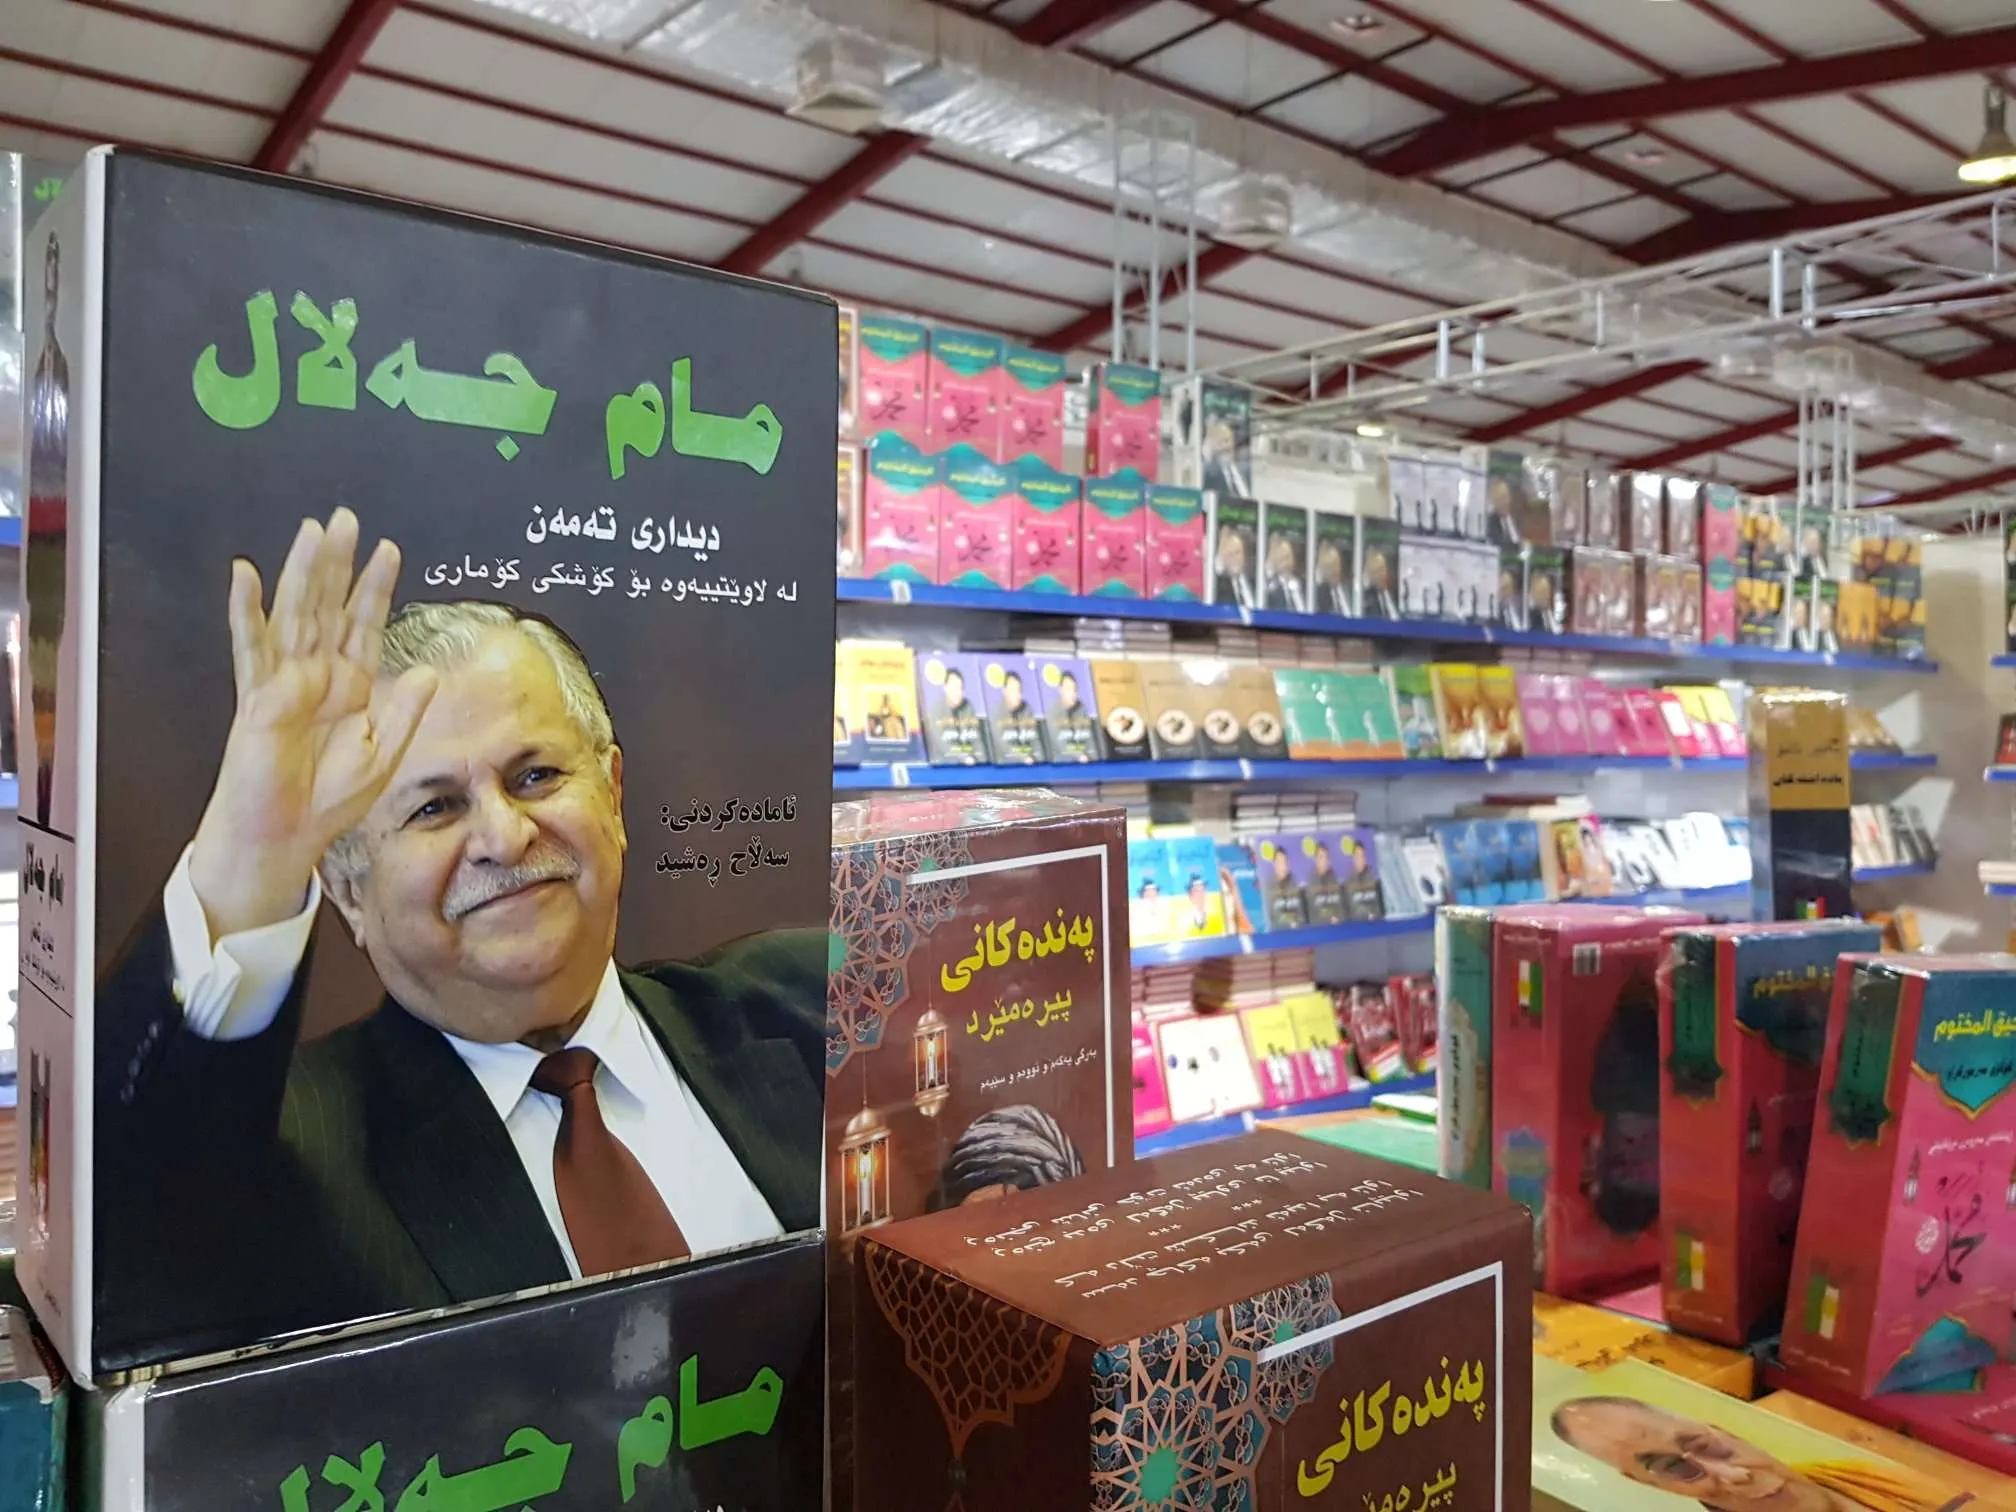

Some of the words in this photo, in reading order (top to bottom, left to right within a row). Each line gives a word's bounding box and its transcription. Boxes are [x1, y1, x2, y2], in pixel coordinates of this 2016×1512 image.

[193, 290, 558, 462] جەلال
[606, 356, 783, 480] مام
[526, 503, 617, 544] تەمەن
[631, 514, 720, 562] دیداری
[424, 554, 521, 590] کۆماری
[531, 562, 615, 596] کۆشکی
[626, 567, 651, 598] بۆ
[776, 580, 798, 602] لە
[940, 907, 1096, 993] پەندەکانی
[617, 1354, 784, 1503] مام
[1296, 1356, 1486, 1498] پەندەکانی
